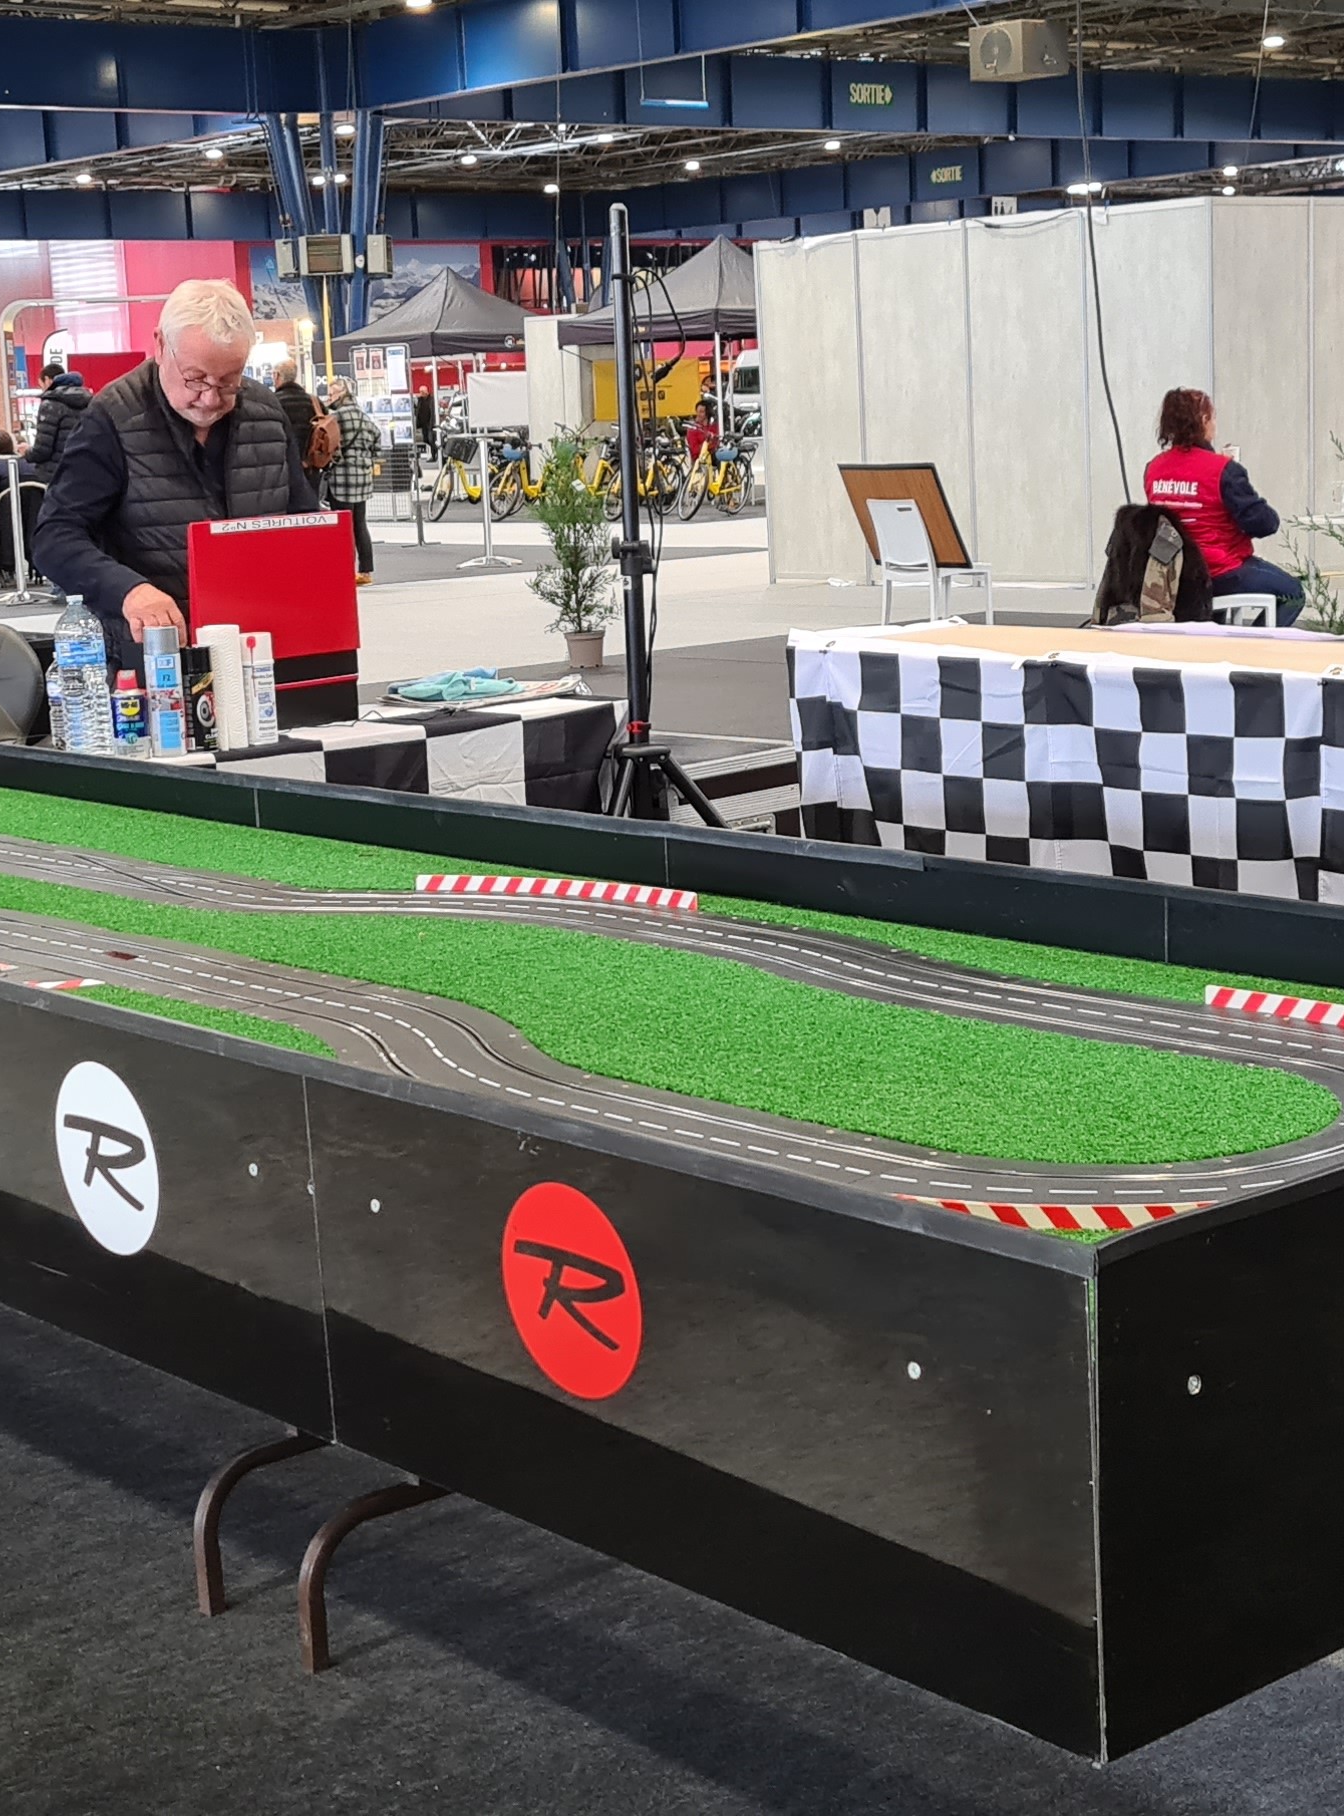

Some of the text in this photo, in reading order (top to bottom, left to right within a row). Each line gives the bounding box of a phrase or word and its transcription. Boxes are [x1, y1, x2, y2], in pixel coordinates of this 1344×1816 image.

[849, 83, 885, 105] SORTIE
[936, 165, 963, 183] SORTIE
[1152, 478, 1199, 496] BÉNÉVOLE
[252, 515, 327, 529] VOITURES
[63, 1113, 147, 1212] R
[513, 1239, 626, 1351] R
